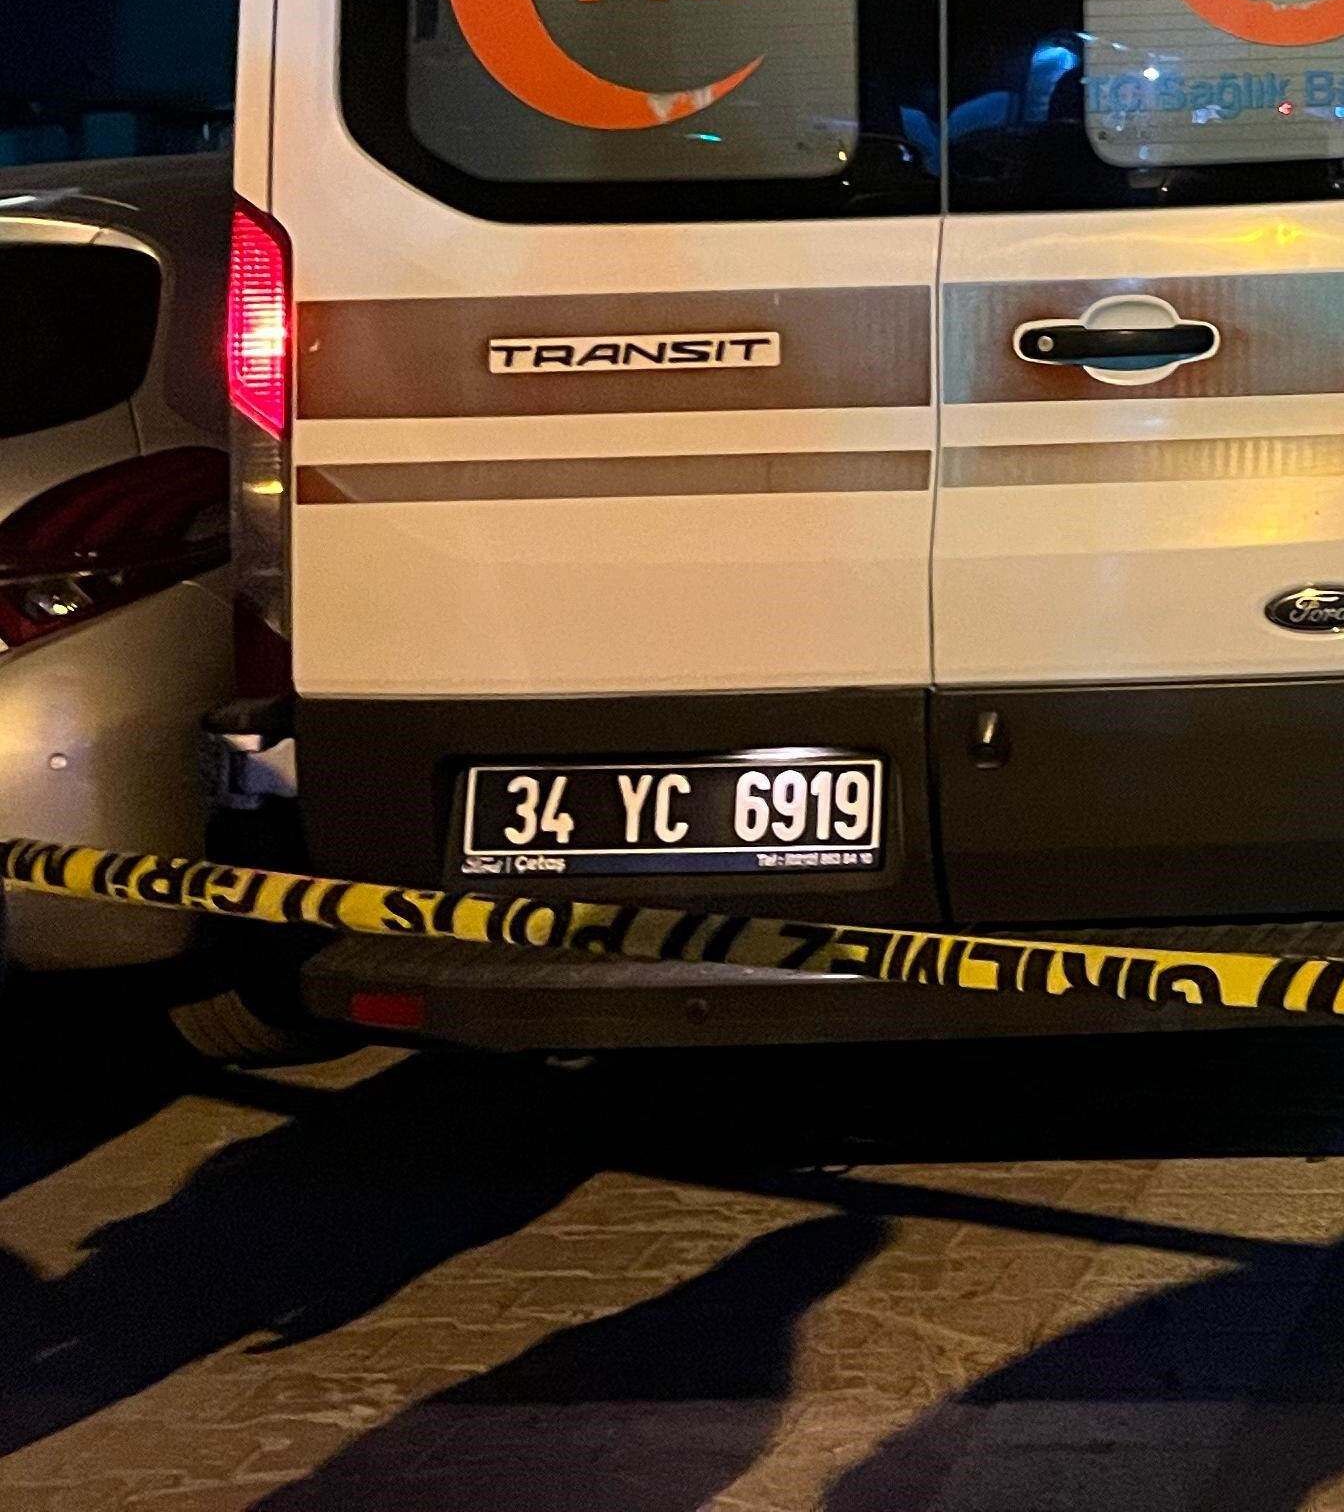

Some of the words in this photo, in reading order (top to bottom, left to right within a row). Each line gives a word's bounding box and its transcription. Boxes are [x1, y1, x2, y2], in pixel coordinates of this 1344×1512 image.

[491, 338, 771, 368] TRANSIT
[504, 775, 575, 845] 34
[617, 773, 692, 843] YC
[734, 769, 869, 842] 6919
